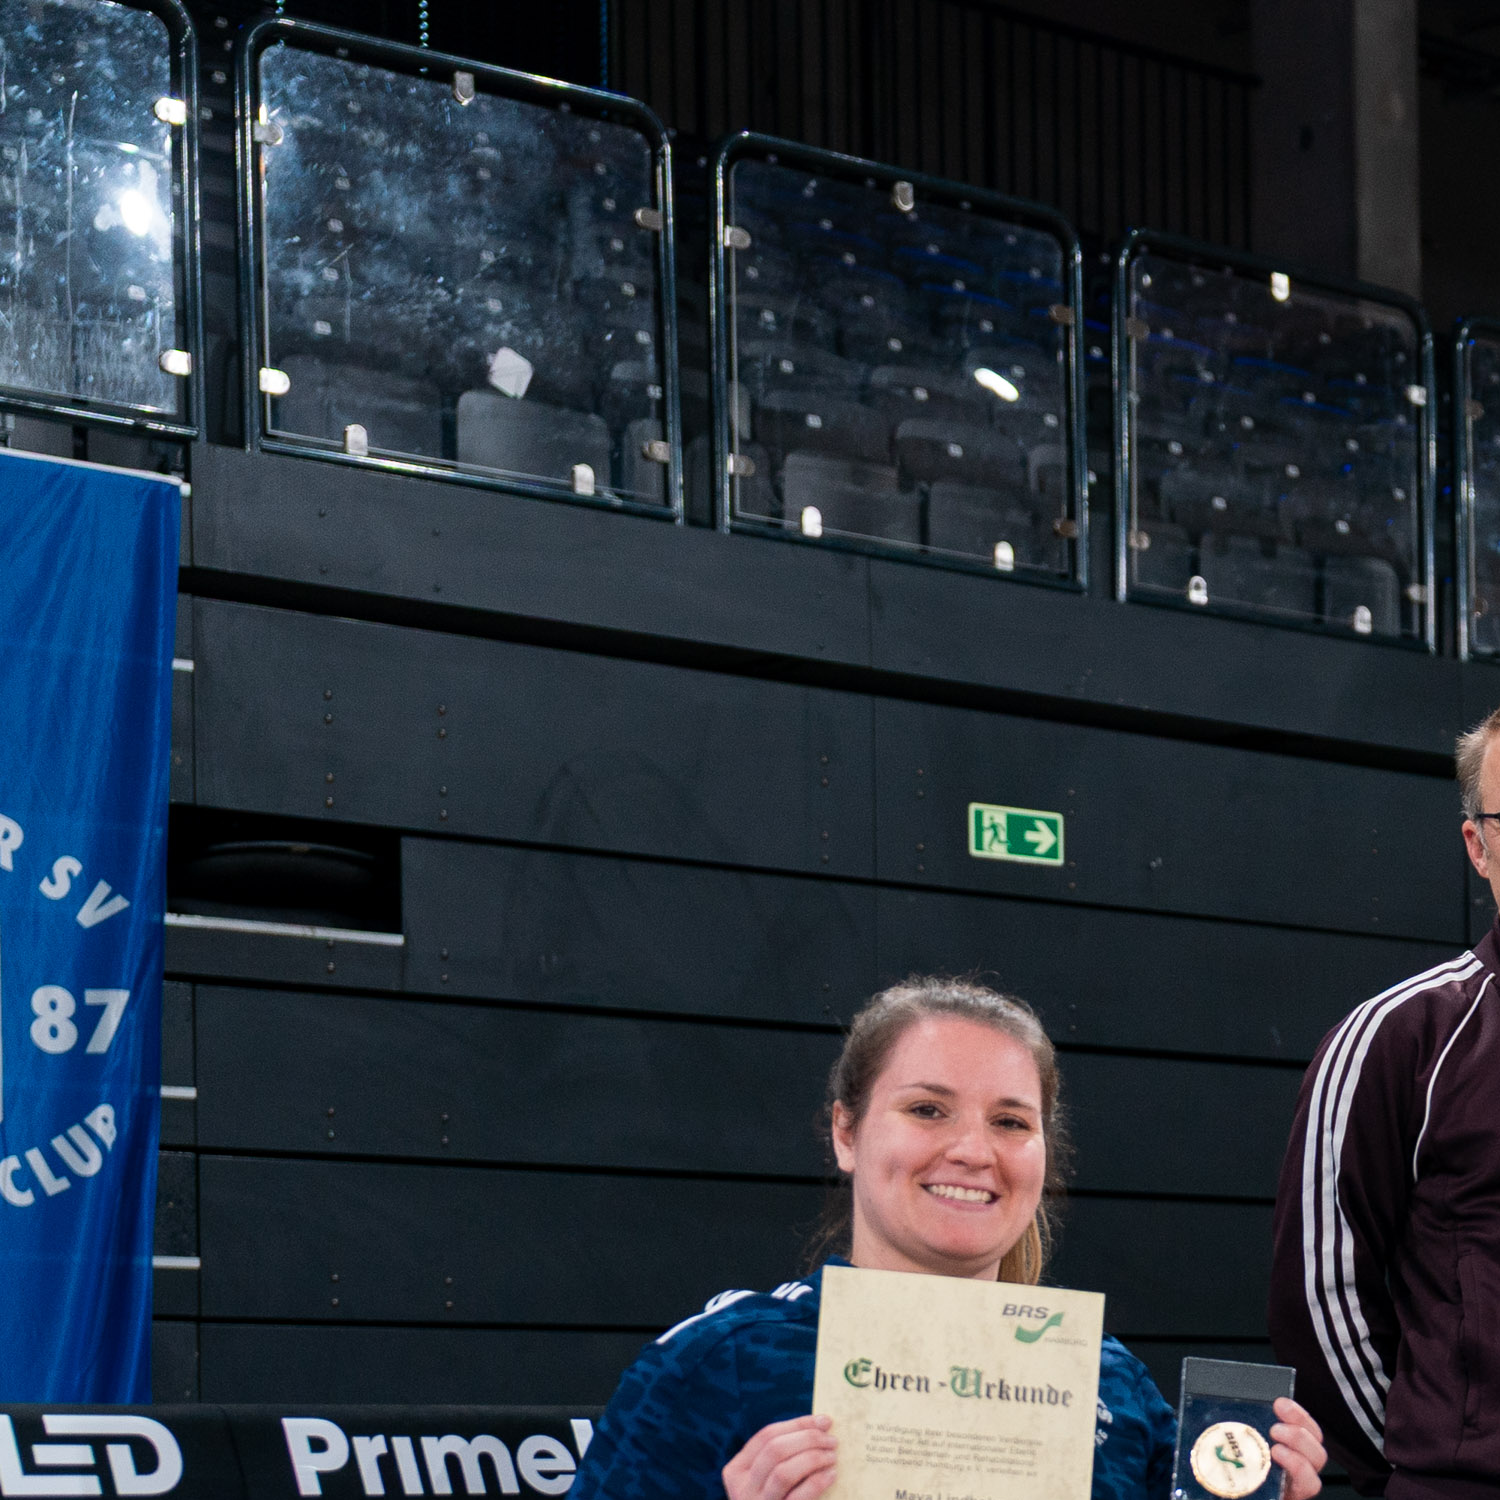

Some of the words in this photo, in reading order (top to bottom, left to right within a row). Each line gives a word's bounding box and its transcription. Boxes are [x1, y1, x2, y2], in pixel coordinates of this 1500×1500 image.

[30, 985, 130, 1054] 87
[0, 1103, 118, 1207] CLUB
[1002, 1303, 1050, 1320] BRS
[281, 1417, 594, 1498] Prime
